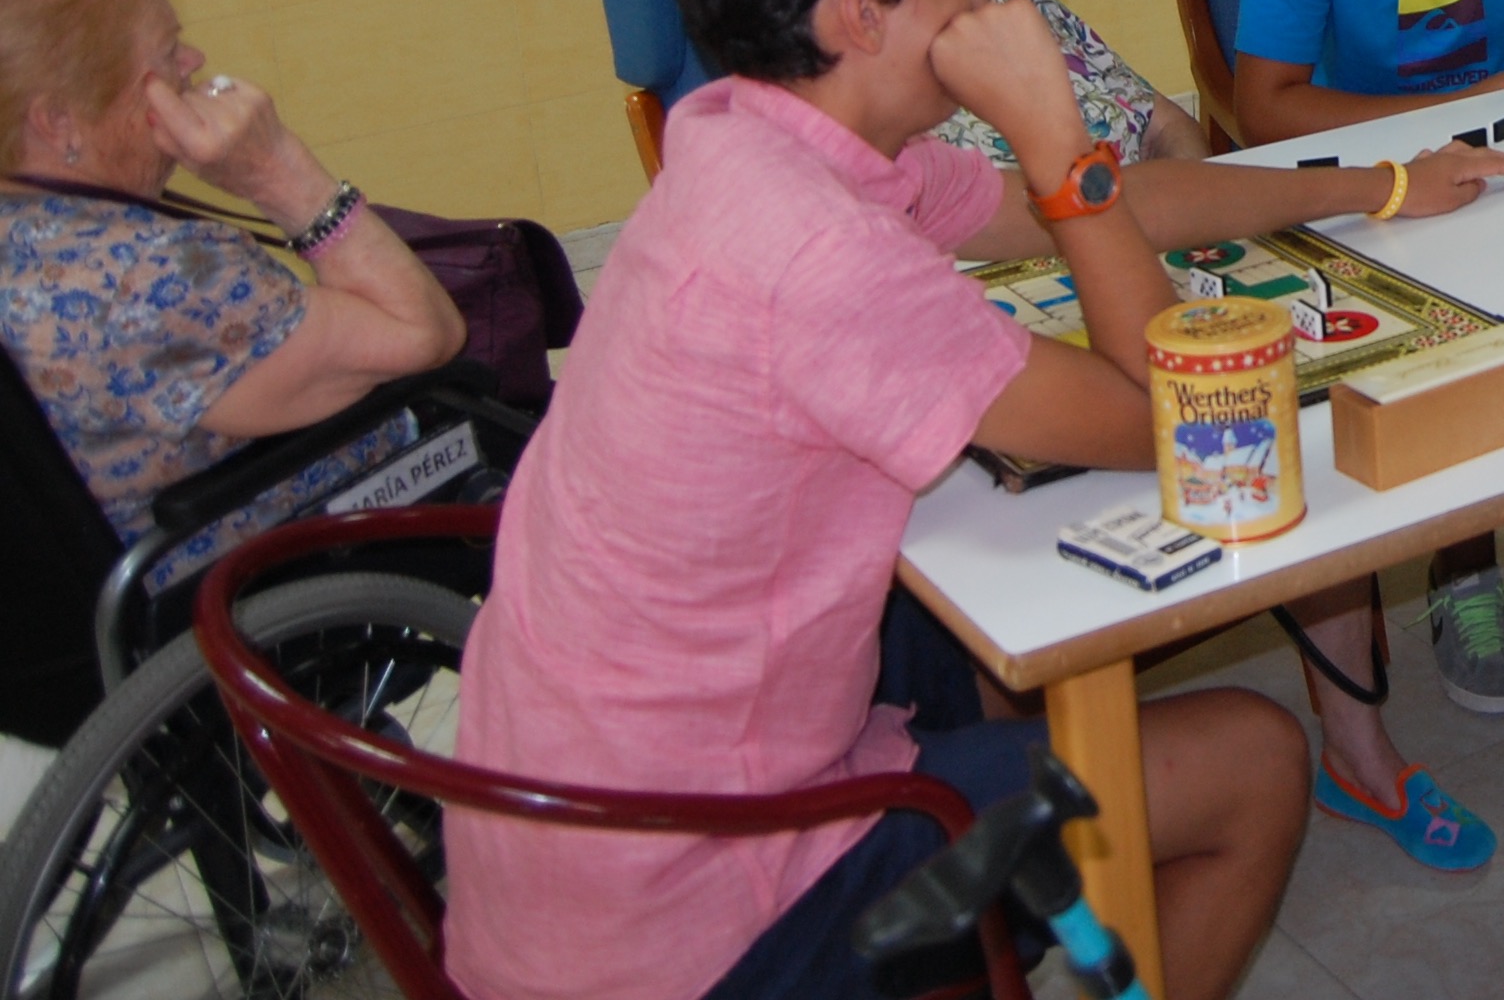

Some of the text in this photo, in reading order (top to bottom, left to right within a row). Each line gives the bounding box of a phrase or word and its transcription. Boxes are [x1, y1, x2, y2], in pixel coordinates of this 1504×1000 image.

[1167, 378, 1273, 408] Werther's
[1180, 401, 1269, 428] Original
[352, 439, 468, 510] ARÍA PÉREZ
